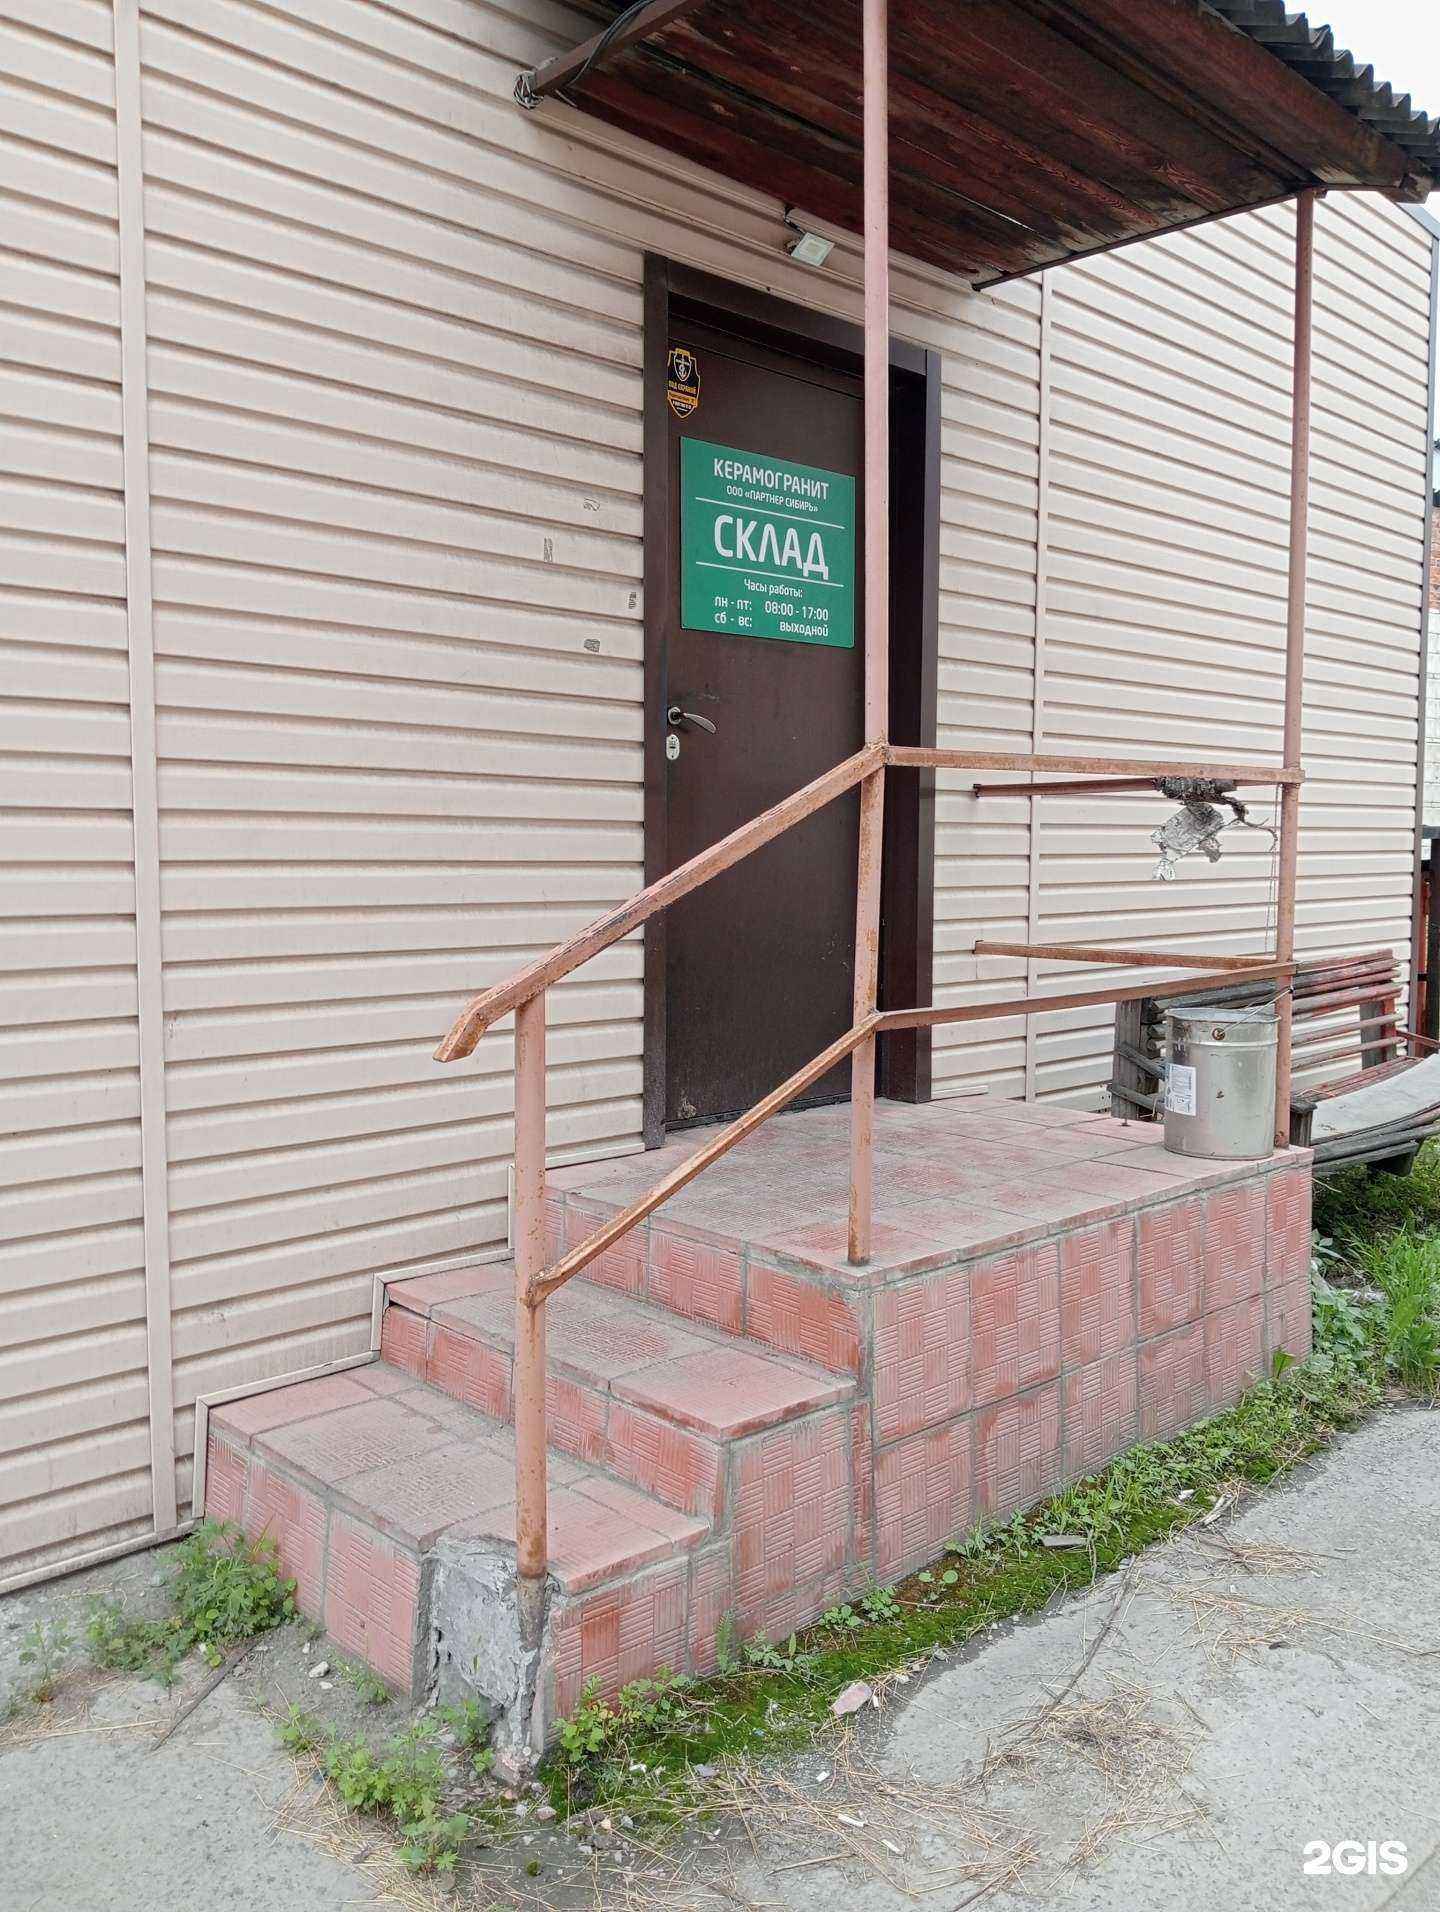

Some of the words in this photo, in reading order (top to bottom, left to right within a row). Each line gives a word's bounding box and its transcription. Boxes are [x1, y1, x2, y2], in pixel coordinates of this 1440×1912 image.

[713, 458, 829, 500] КЕРАМОГРАНИТ
[726, 485, 743, 497] ООО
[745, 489, 784, 504] «ПАРТНЕР
[785, 497, 819, 512] СИБИРЬ»
[714, 514, 829, 580] СКЛАД
[744, 578, 767, 593] Часы
[769, 584, 803, 598] работы:
[737, 599, 752, 611] пт:
[764, 600, 794, 617] 08:00
[802, 606, 829, 621] 17:00
[714, 612, 727, 624] сб
[738, 616, 752, 628] вс:
[779, 621, 829, 637] выходной
